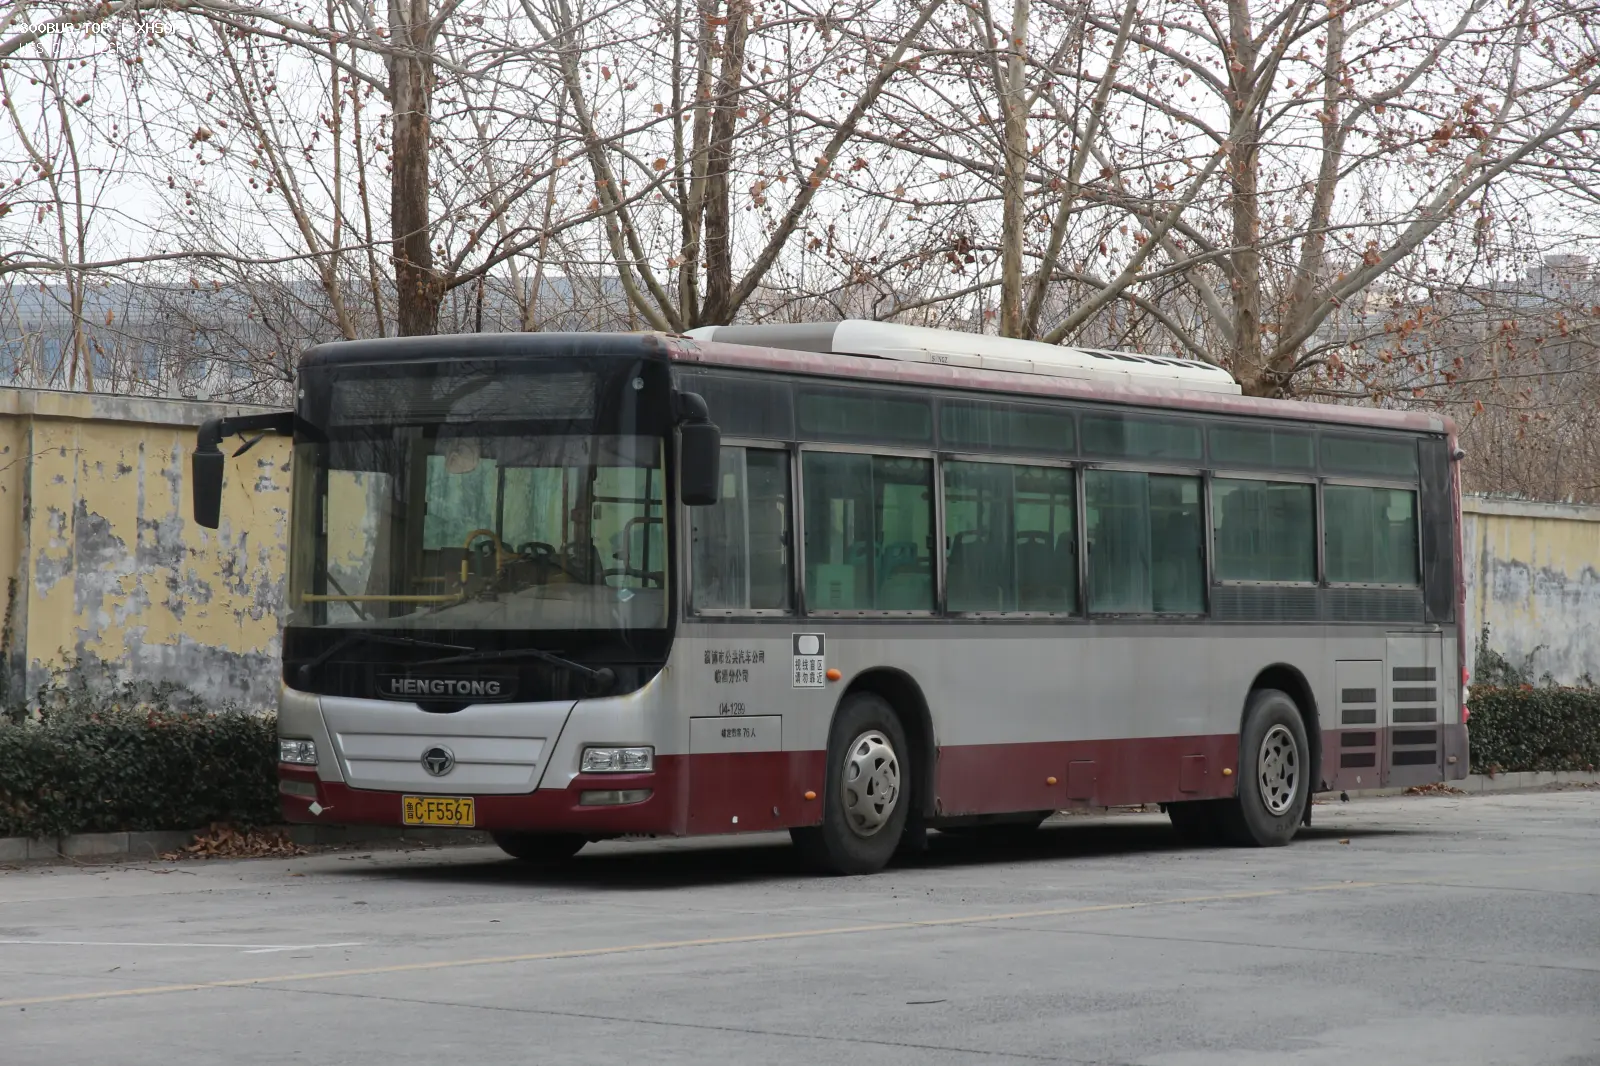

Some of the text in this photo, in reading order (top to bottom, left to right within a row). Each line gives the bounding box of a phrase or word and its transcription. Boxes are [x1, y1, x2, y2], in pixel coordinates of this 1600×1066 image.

[795, 658, 822, 671] 视线盲区
[795, 671, 822, 684] 请勿靠近
[391, 678, 501, 695] HENGTONG
[719, 702, 746, 715] 04-1299
